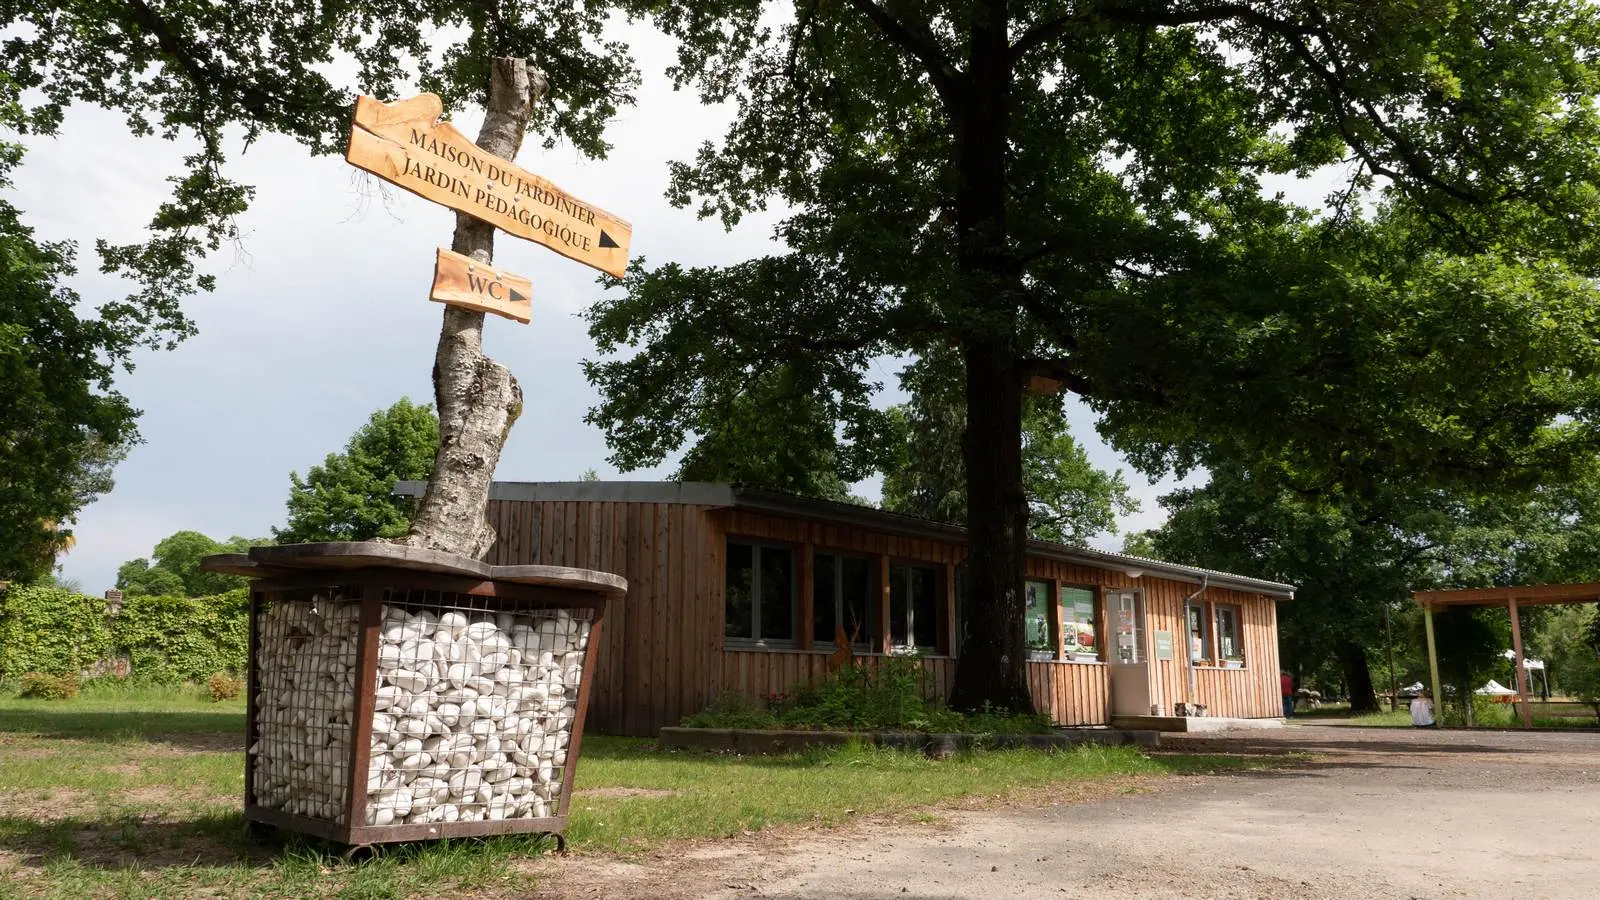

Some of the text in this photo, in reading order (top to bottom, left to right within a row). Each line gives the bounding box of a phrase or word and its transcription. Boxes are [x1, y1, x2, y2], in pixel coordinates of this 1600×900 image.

[402, 157, 592, 253] JARDIN PEDAGOGIQUE
[409, 128, 596, 227] MAISON DU JARDINIER
[468, 273, 503, 300] WC
